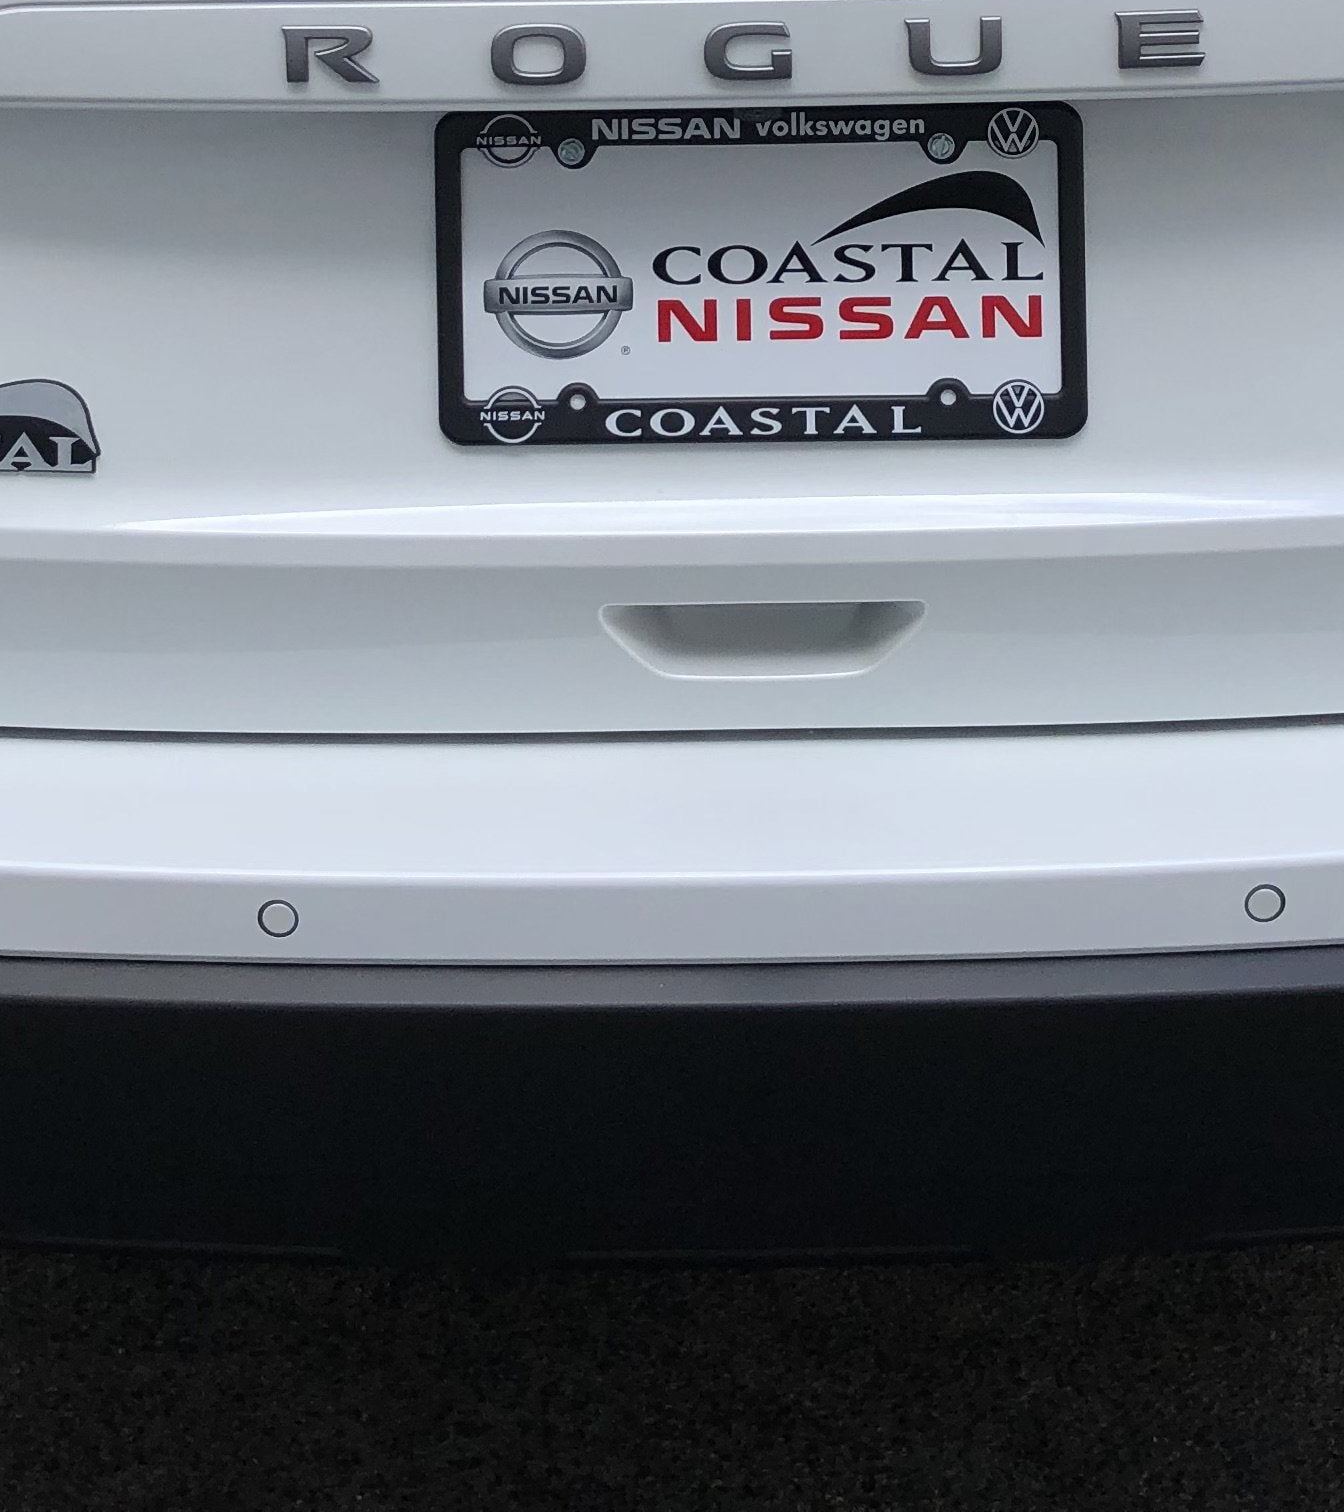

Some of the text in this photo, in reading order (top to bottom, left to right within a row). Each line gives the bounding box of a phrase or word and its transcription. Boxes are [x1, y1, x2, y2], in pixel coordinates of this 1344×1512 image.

[280, 8, 1208, 86] ROGUE
[476, 135, 542, 146] NISSAN
[590, 111, 926, 143] NISSAN volkswagen
[651, 240, 1044, 286] COASTAL
[497, 284, 619, 306] NISSAN
[656, 294, 1043, 343] NISSAN
[479, 410, 546, 421] NISSAN
[604, 404, 923, 438] COASTAL
